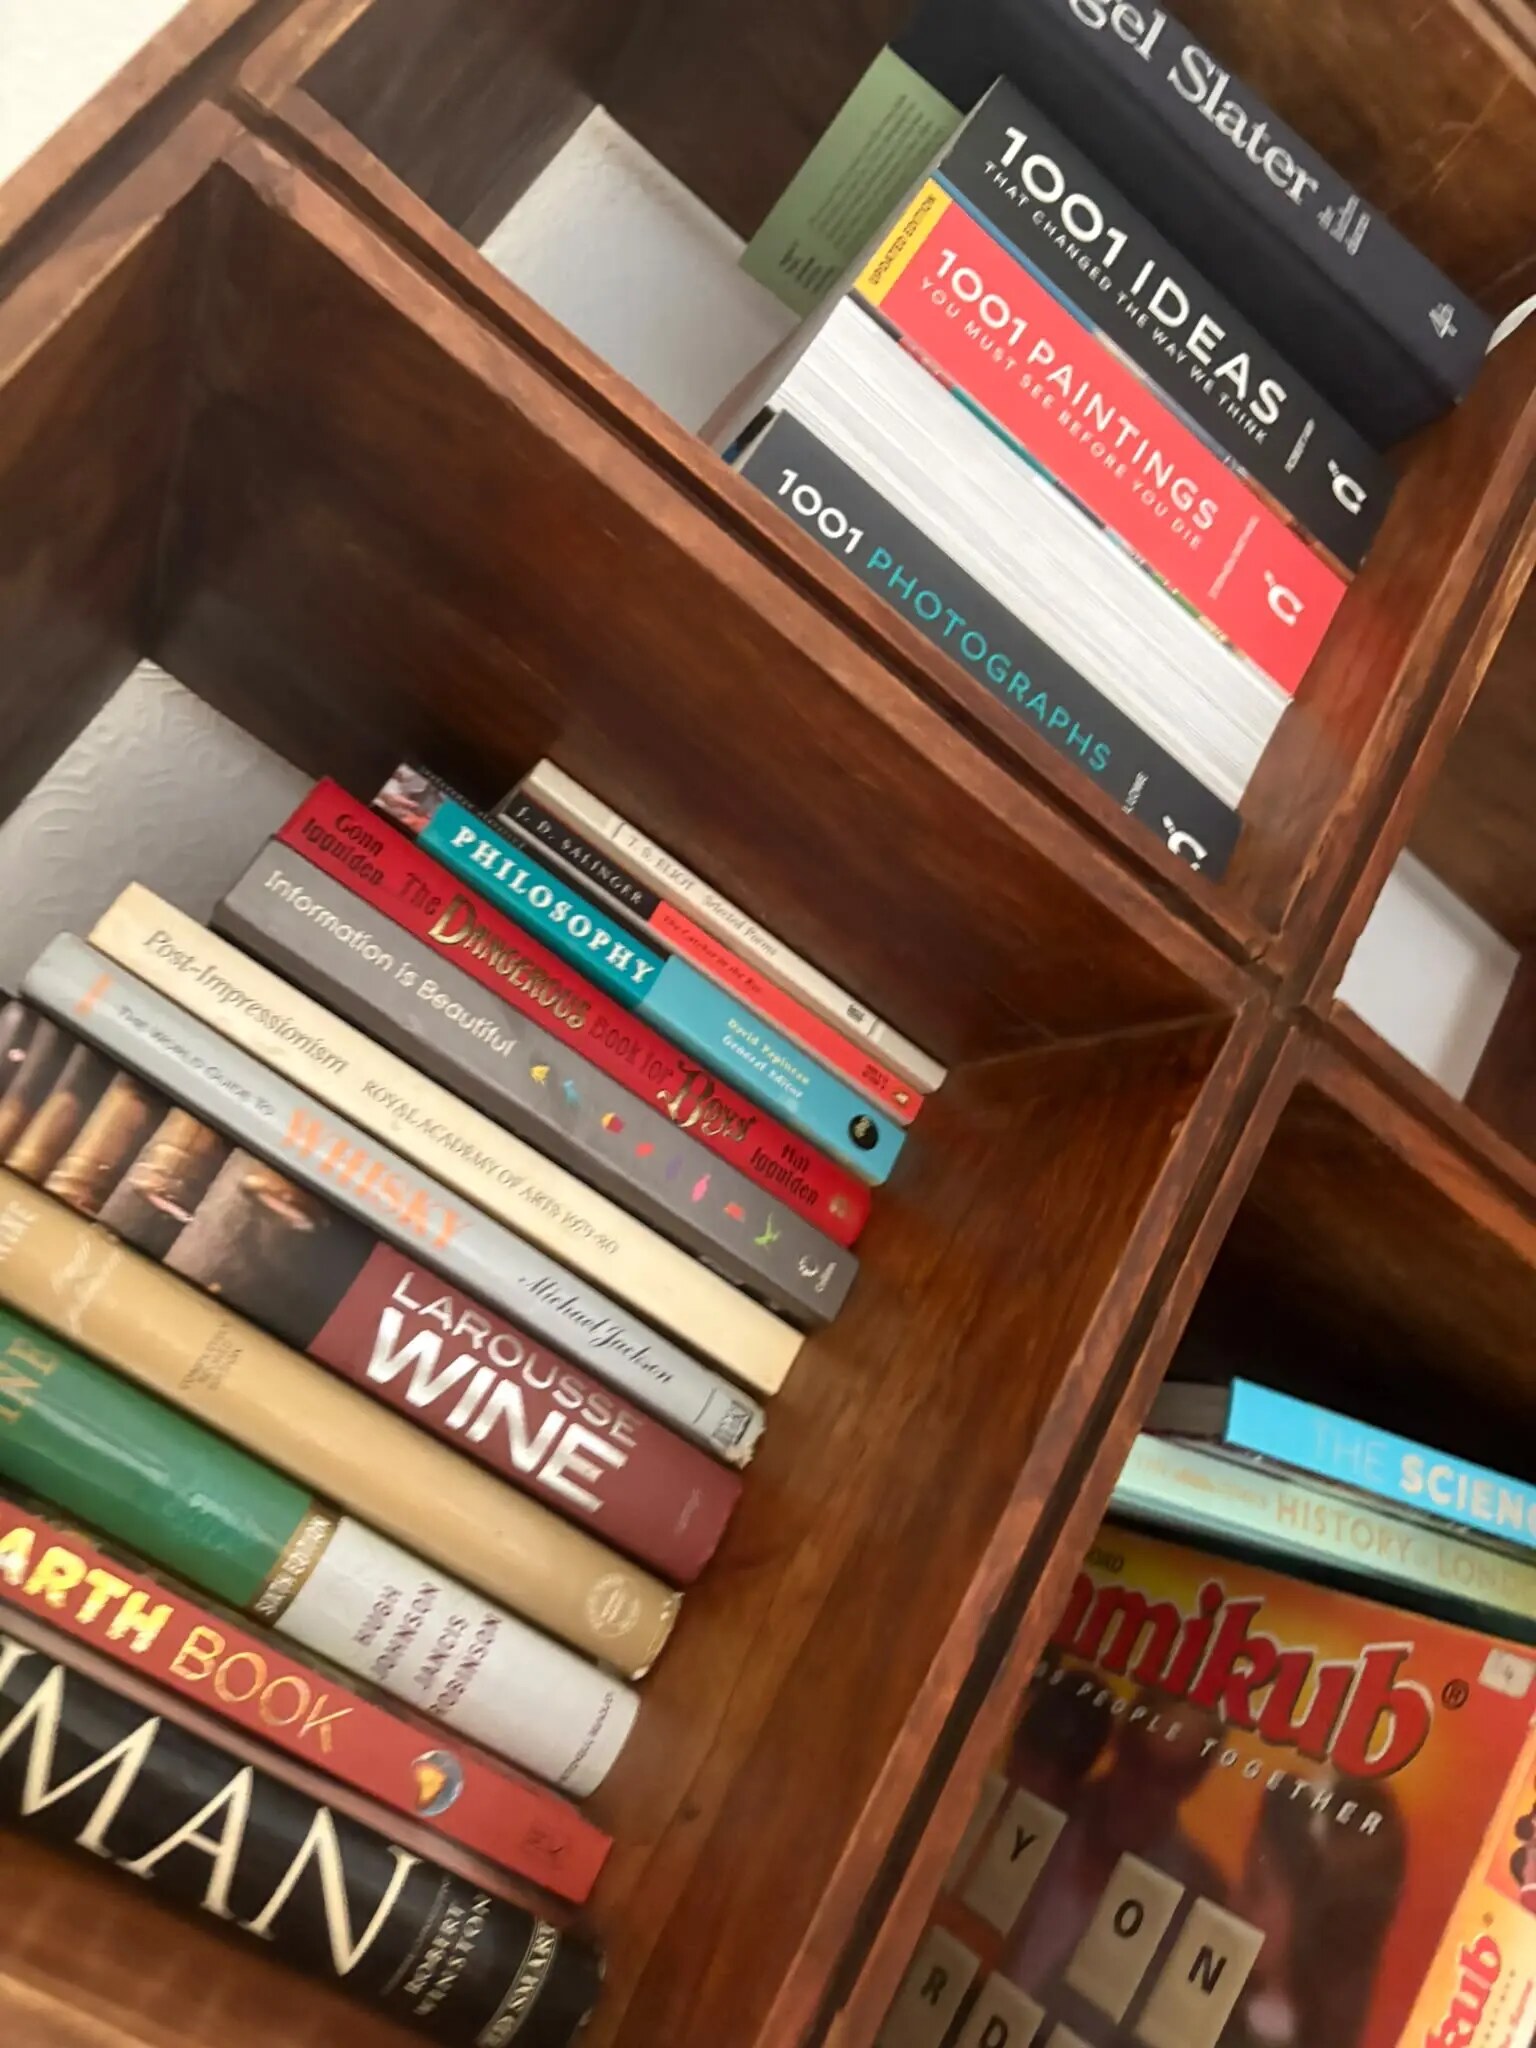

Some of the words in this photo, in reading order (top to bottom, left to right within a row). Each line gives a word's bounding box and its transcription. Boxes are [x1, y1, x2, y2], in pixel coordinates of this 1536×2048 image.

[1167, 45, 1320, 206] Slater
[983, 160, 1029, 209] THAT
[1033, 210, 1114, 295] CHANGED
[1116, 290, 1148, 330] THE
[1151, 327, 1189, 367] WAY
[1190, 365, 1216, 396] WE
[1218, 391, 1270, 445] THINK
[999, 127, 1129, 269] 1001
[1130, 259, 1288, 426] IDEAS
[920, 278, 959, 321] YOU
[963, 317, 1017, 373] MUST
[1019, 371, 1055, 411] SEE
[1058, 404, 1128, 480] BEFORE
[1131, 473, 1169, 519] YOU
[1171, 515, 1203, 552] DIE
[936, 248, 1029, 347] 1001
[1027, 338, 1219, 531] PAINTINGS
[776, 467, 865, 554] 1001
[865, 545, 1113, 773] PHOTOGRAPHS
[399, 872, 443, 917] The
[450, 825, 655, 984] PHILOSOPHY
[561, 838, 643, 905] SALINGER
[264, 869, 394, 973] Information
[394, 962, 419, 988] is
[416, 978, 518, 1059] Beautiful
[143, 929, 350, 1075] Post-Impressionism
[361, 1078, 417, 1122] ROYAL
[417, 1117, 501, 1178] ACADEMY
[280, 1105, 474, 1250] WHISKY
[518, 1275, 607, 1347] Michael
[592, 1318, 676, 1385] Jackson
[366, 1306, 630, 1514] WINE
[391, 1270, 643, 1448] LAROUSSE
[1275, 1491, 1414, 1565] HISTORY
[1312, 1418, 1388, 1482] THE
[0, 1526, 175, 1655] ARTH
[168, 1625, 355, 1754] BOOK
[353, 1584, 404, 1648] HUGH
[369, 1580, 442, 1682] JOHNSON
[413, 1613, 471, 1692] JANCIS
[429, 1610, 504, 1717] ROBINSON
[0, 1636, 423, 1977] MAN
[1075, 1681, 1184, 1742] PEOPLE
[1200, 1736, 1386, 1837] TOGETHER
[1009, 1826, 1036, 1864] Y
[919, 1965, 948, 2005] R
[1113, 1899, 1146, 1939] O
[1186, 1945, 1228, 1996] N
